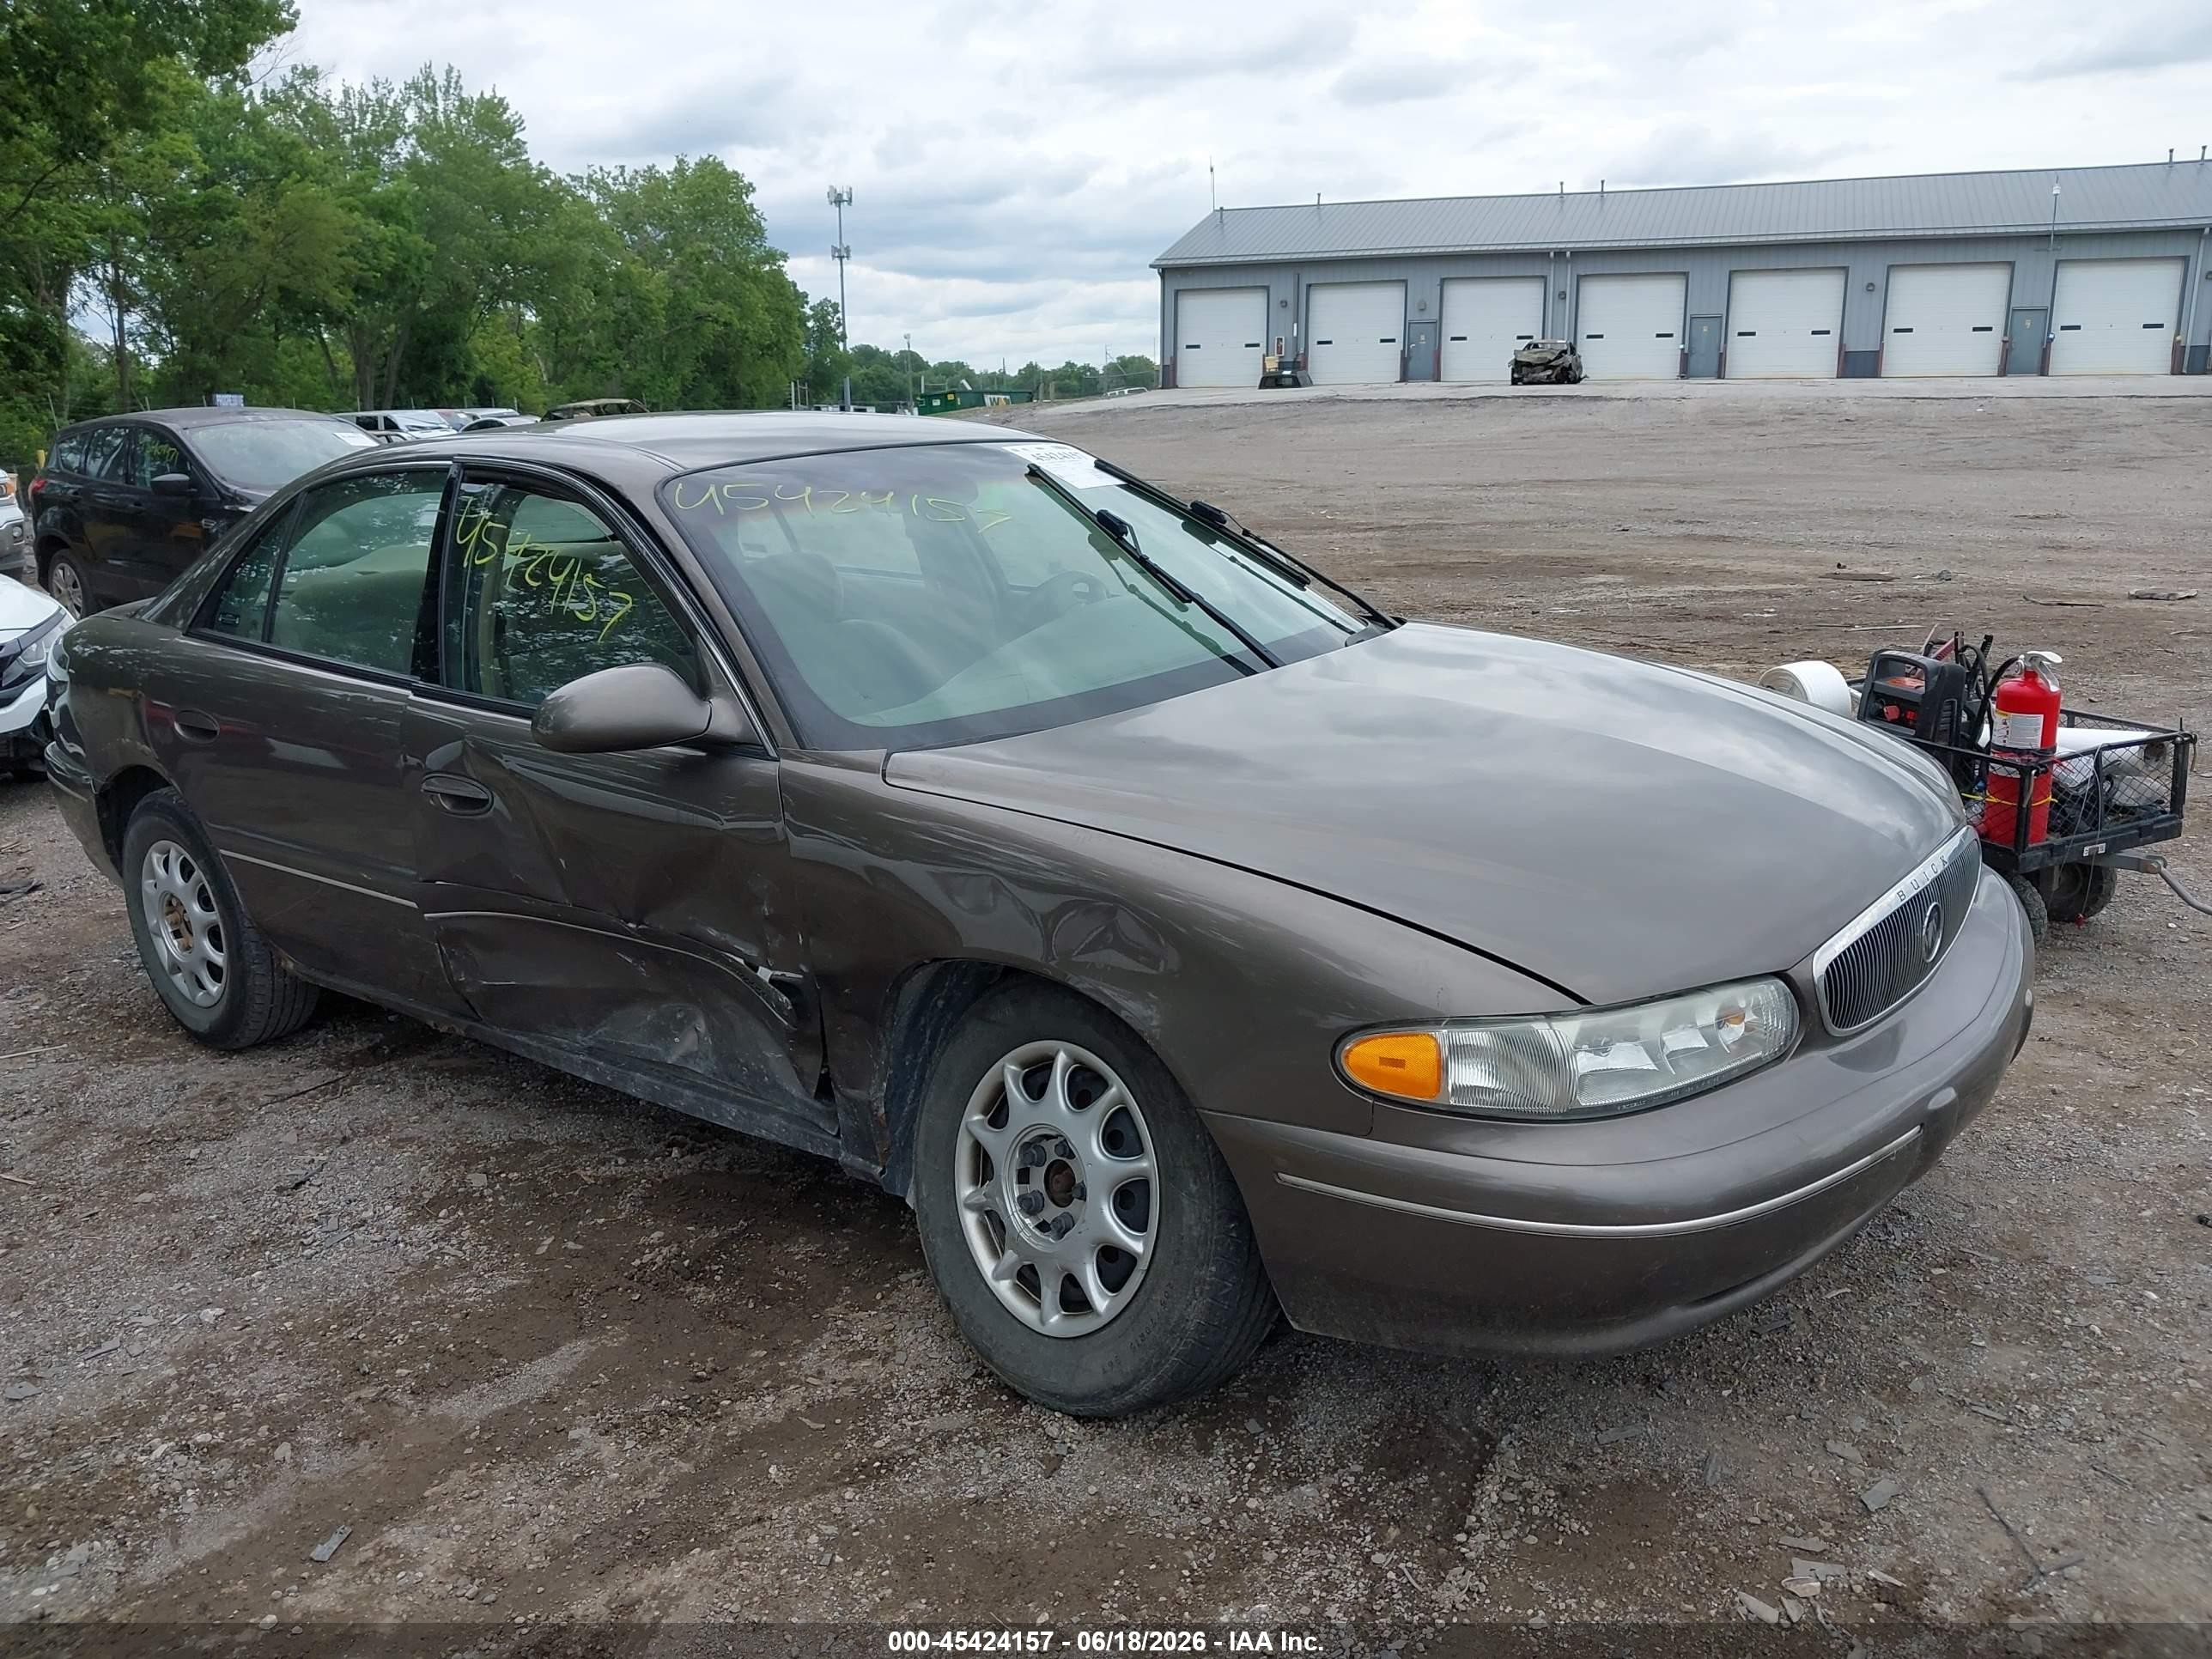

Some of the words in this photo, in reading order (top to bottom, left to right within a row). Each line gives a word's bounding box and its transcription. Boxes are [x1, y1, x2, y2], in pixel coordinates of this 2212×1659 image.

[675, 483, 1013, 533] 45424157
[455, 496, 633, 644] 45424157
[1896, 855, 1948, 902] BUICK
